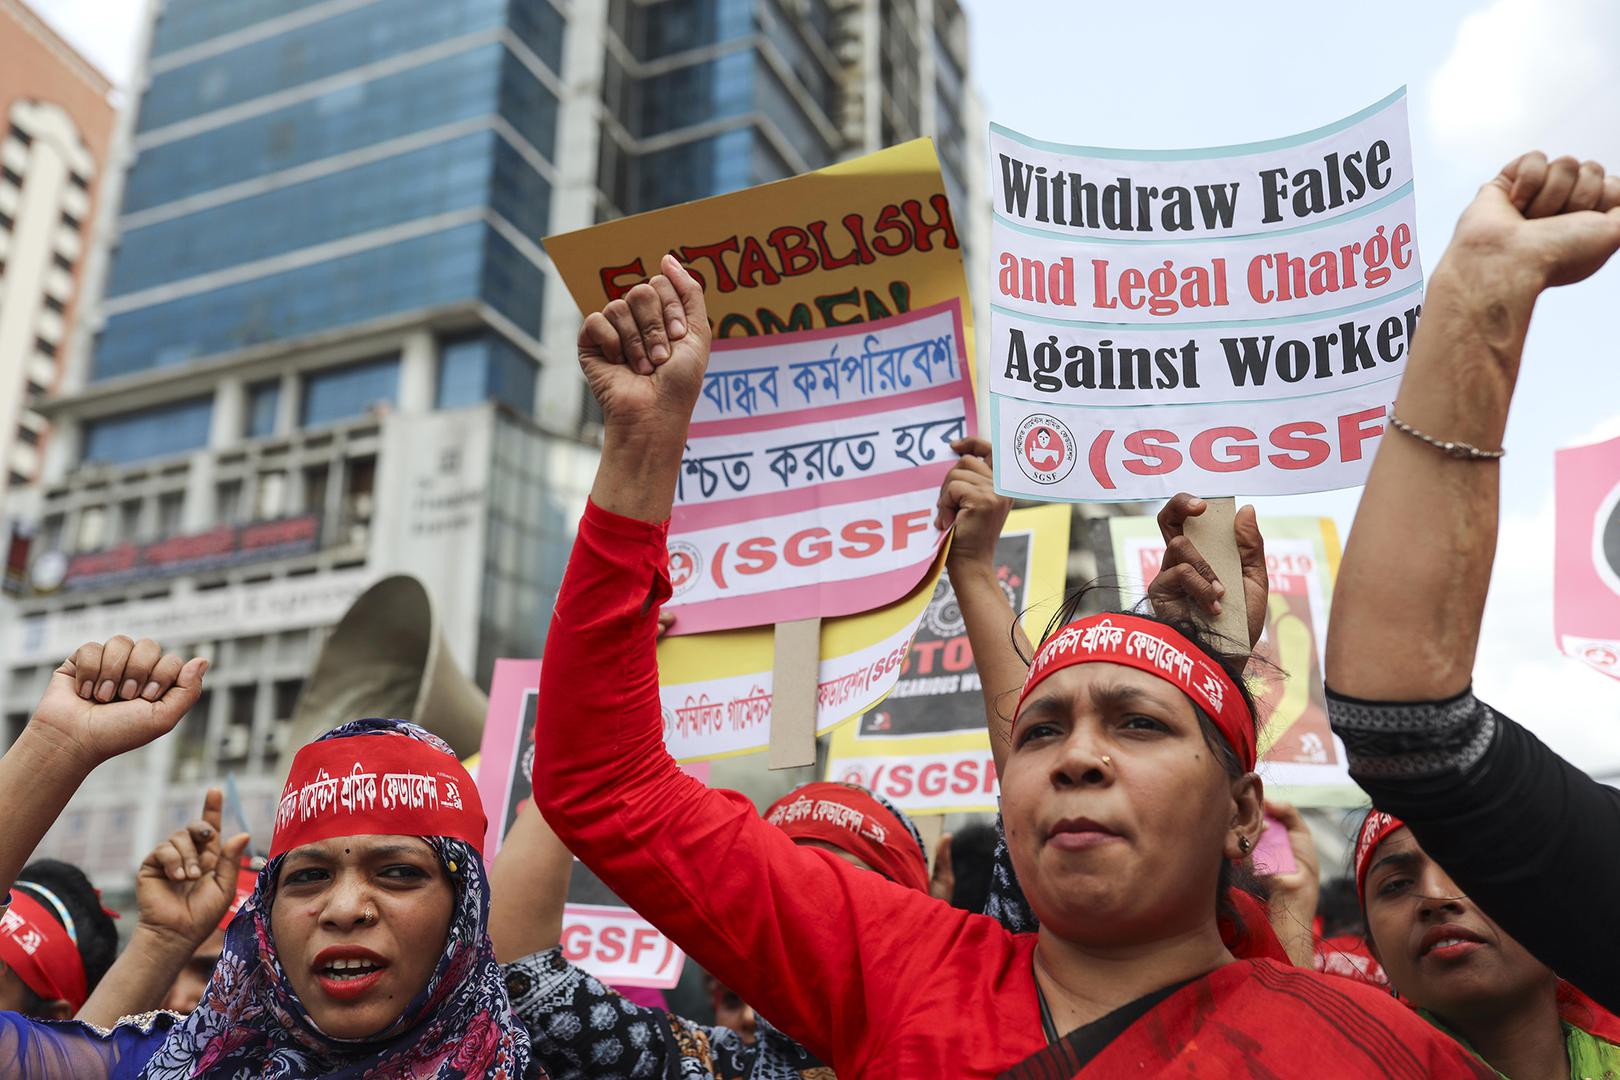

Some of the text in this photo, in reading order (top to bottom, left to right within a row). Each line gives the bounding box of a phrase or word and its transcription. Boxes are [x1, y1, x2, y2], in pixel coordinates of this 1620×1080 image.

[999, 139, 1392, 232] Withdraw False
[599, 194, 959, 303] ETABLISH
[999, 222, 1413, 317] and Legal Charge
[709, 280, 912, 339] OMEN
[703, 335, 955, 417] বান্ধব কর্মপরিবেশ
[1004, 327, 1201, 393] Against
[766, 432, 879, 488] করতে
[1033, 472, 1057, 481] SGSF
[1088, 402, 1397, 490] (SGSF
[710, 508, 946, 590] (SGSF
[1081, 619, 1126, 654] শ্রমিক
[341, 762, 377, 815] শ্রমিক
